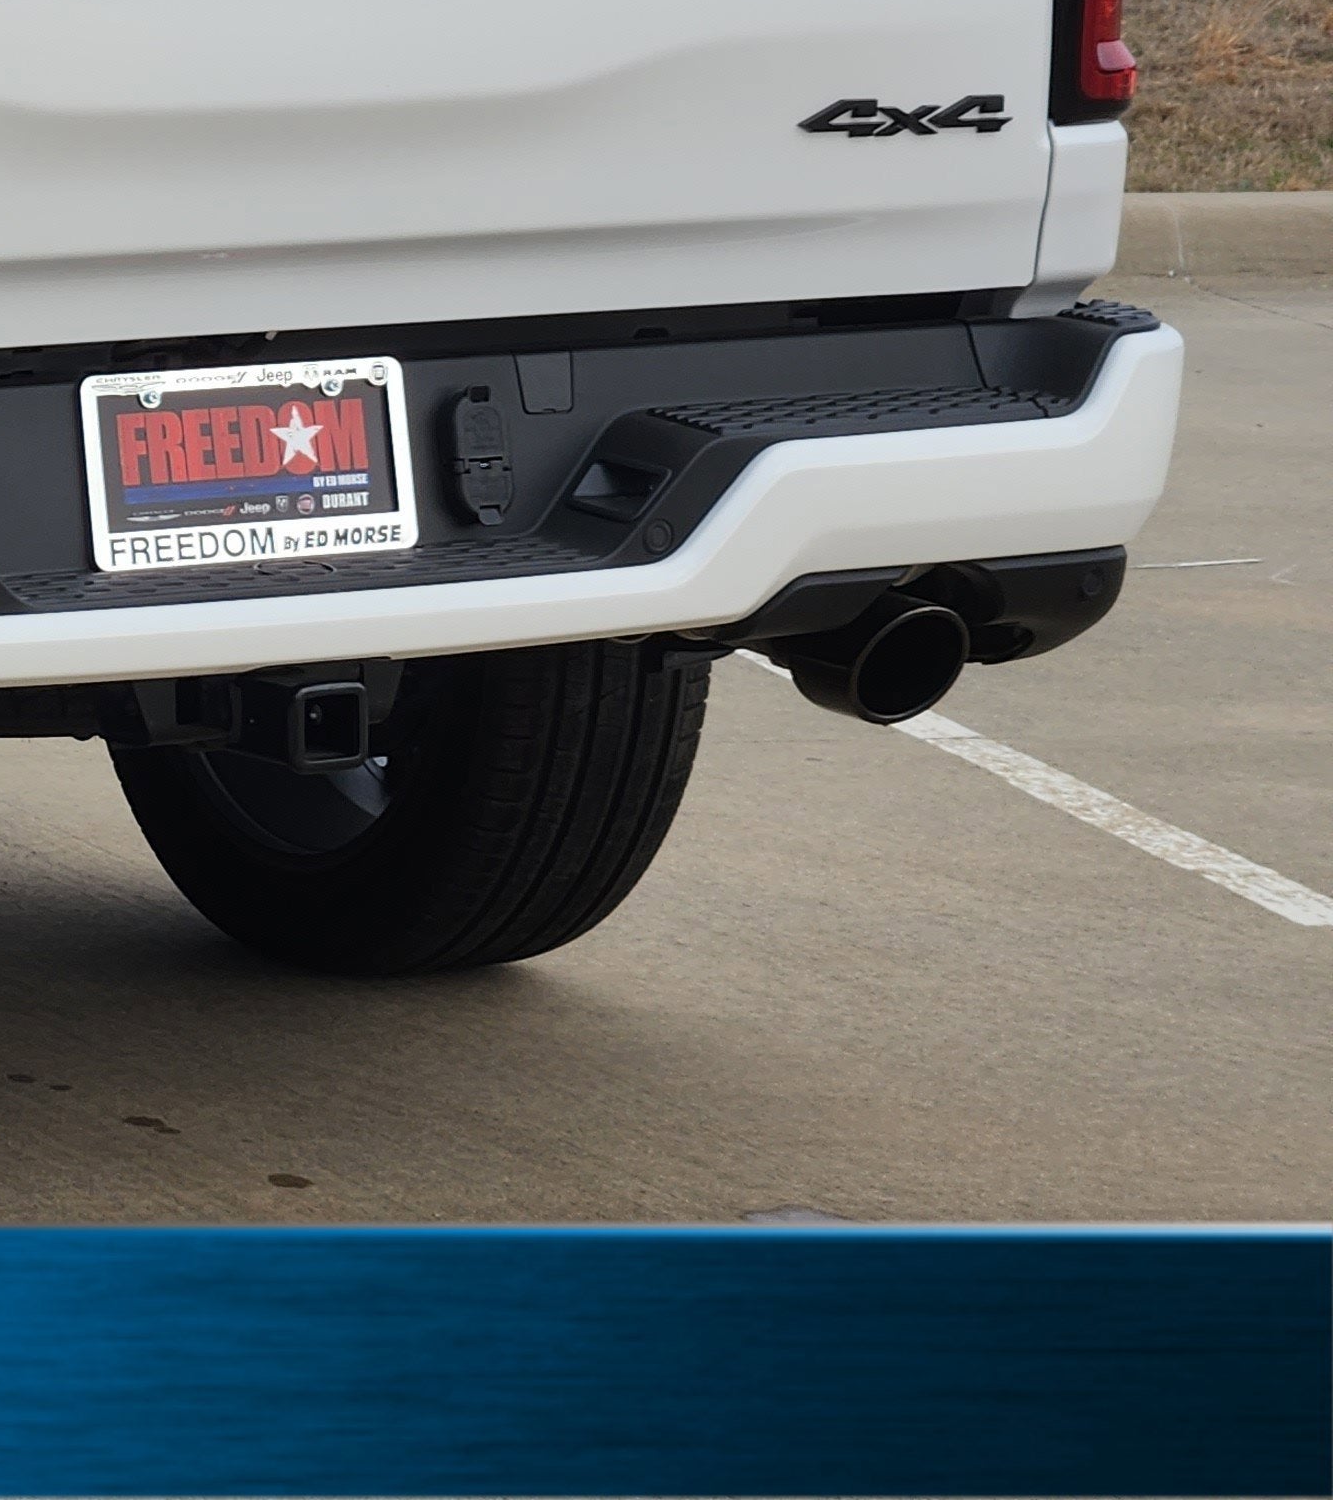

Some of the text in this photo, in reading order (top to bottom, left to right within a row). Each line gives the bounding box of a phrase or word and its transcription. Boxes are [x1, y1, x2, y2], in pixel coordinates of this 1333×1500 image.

[796, 94, 1014, 138] 4x4
[256, 367, 294, 385] Jeep
[322, 367, 358, 377] RAM
[115, 397, 370, 486] FREEDOM
[239, 501, 271, 515] Jeep
[322, 491, 370, 509] DURANT
[108, 526, 276, 567] FREEDOM
[304, 530, 329, 548] ED
[333, 523, 402, 547] MORSE
